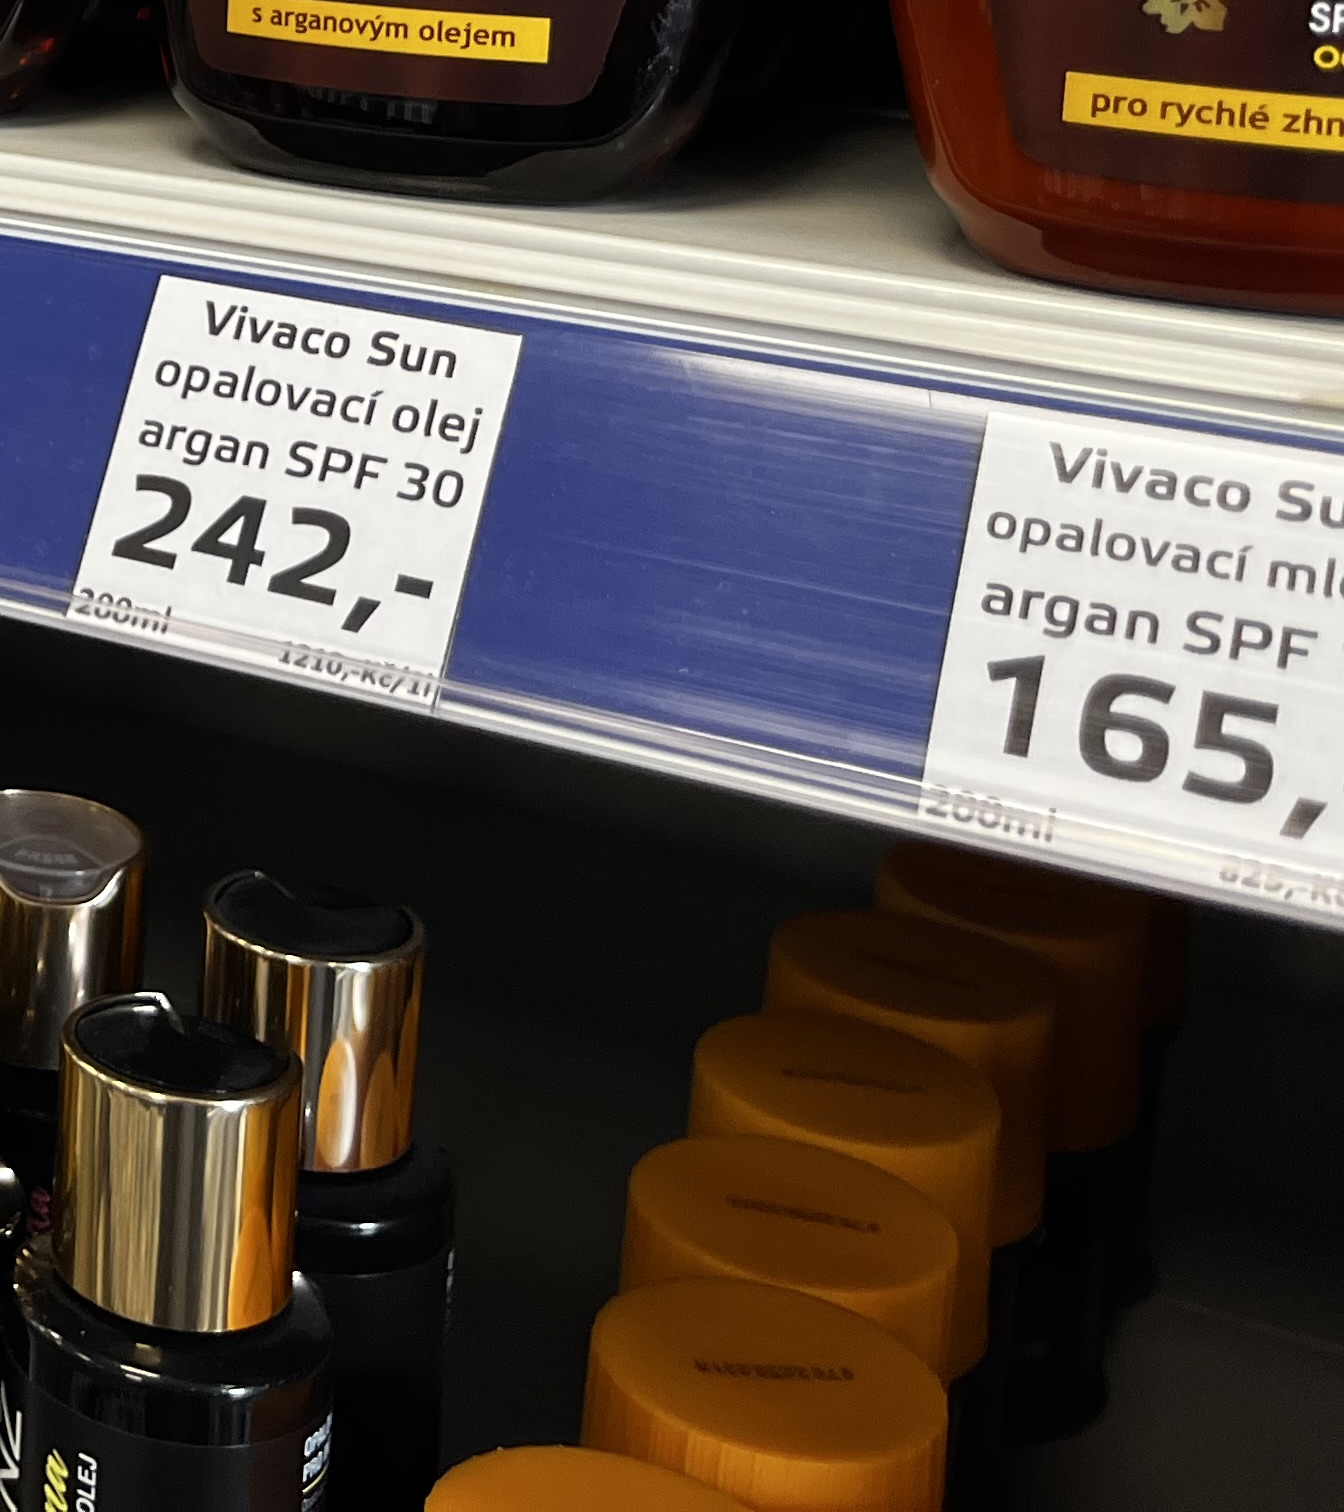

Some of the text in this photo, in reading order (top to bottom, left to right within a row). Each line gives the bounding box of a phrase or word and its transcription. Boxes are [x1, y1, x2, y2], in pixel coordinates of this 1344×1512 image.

[252, 5, 516, 49] s arganovým olejem
[1090, 92, 1270, 130] pro rychlé
[205, 299, 458, 379] Vivaco Sun
[154, 358, 484, 455] opalovací olej
[138, 418, 465, 509] argan SPF 30
[1049, 441, 1252, 513] Vivaco
[111, 473, 434, 634] 242,-
[986, 510, 1254, 583] opalovací
[980, 580, 1319, 671] argan SPF
